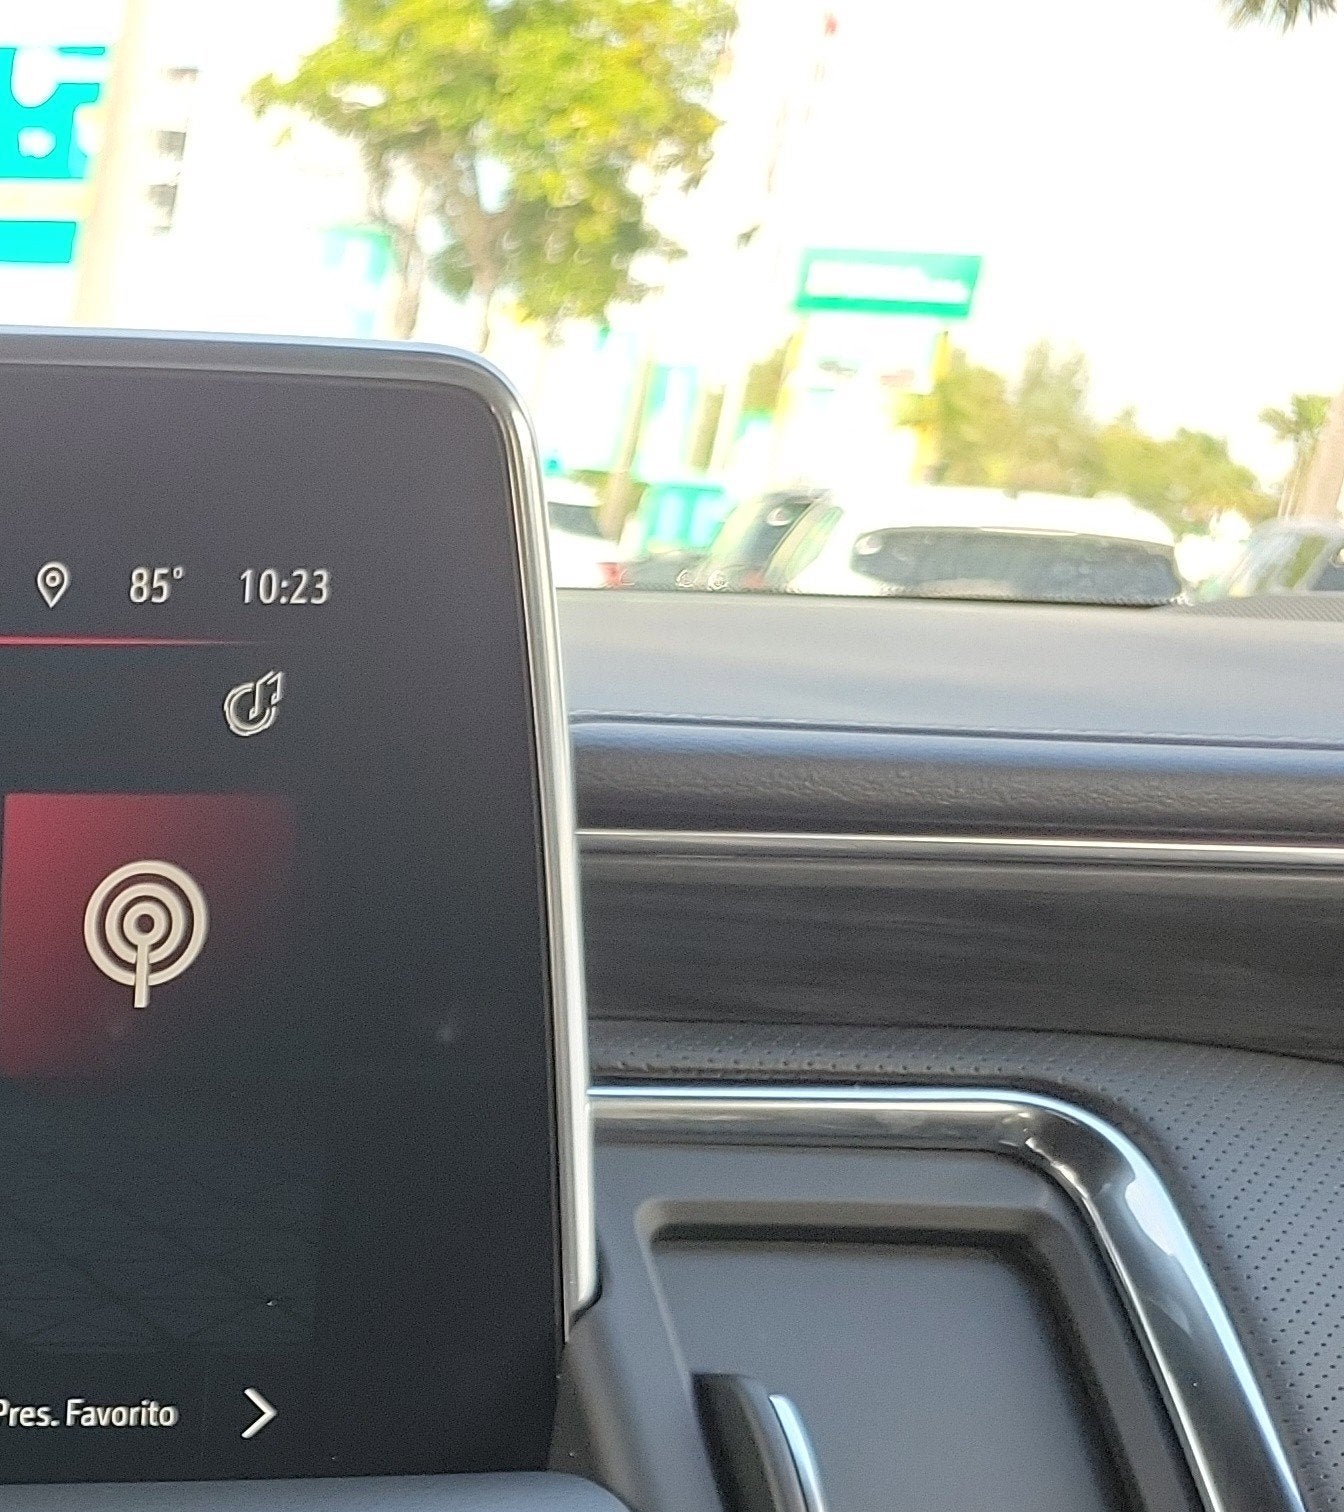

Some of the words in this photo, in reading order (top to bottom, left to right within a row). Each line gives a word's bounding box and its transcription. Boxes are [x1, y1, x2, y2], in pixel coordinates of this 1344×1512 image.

[129, 565, 184, 605] 85°
[239, 567, 330, 605] 10:23
[65, 1398, 179, 1428] Favorito
